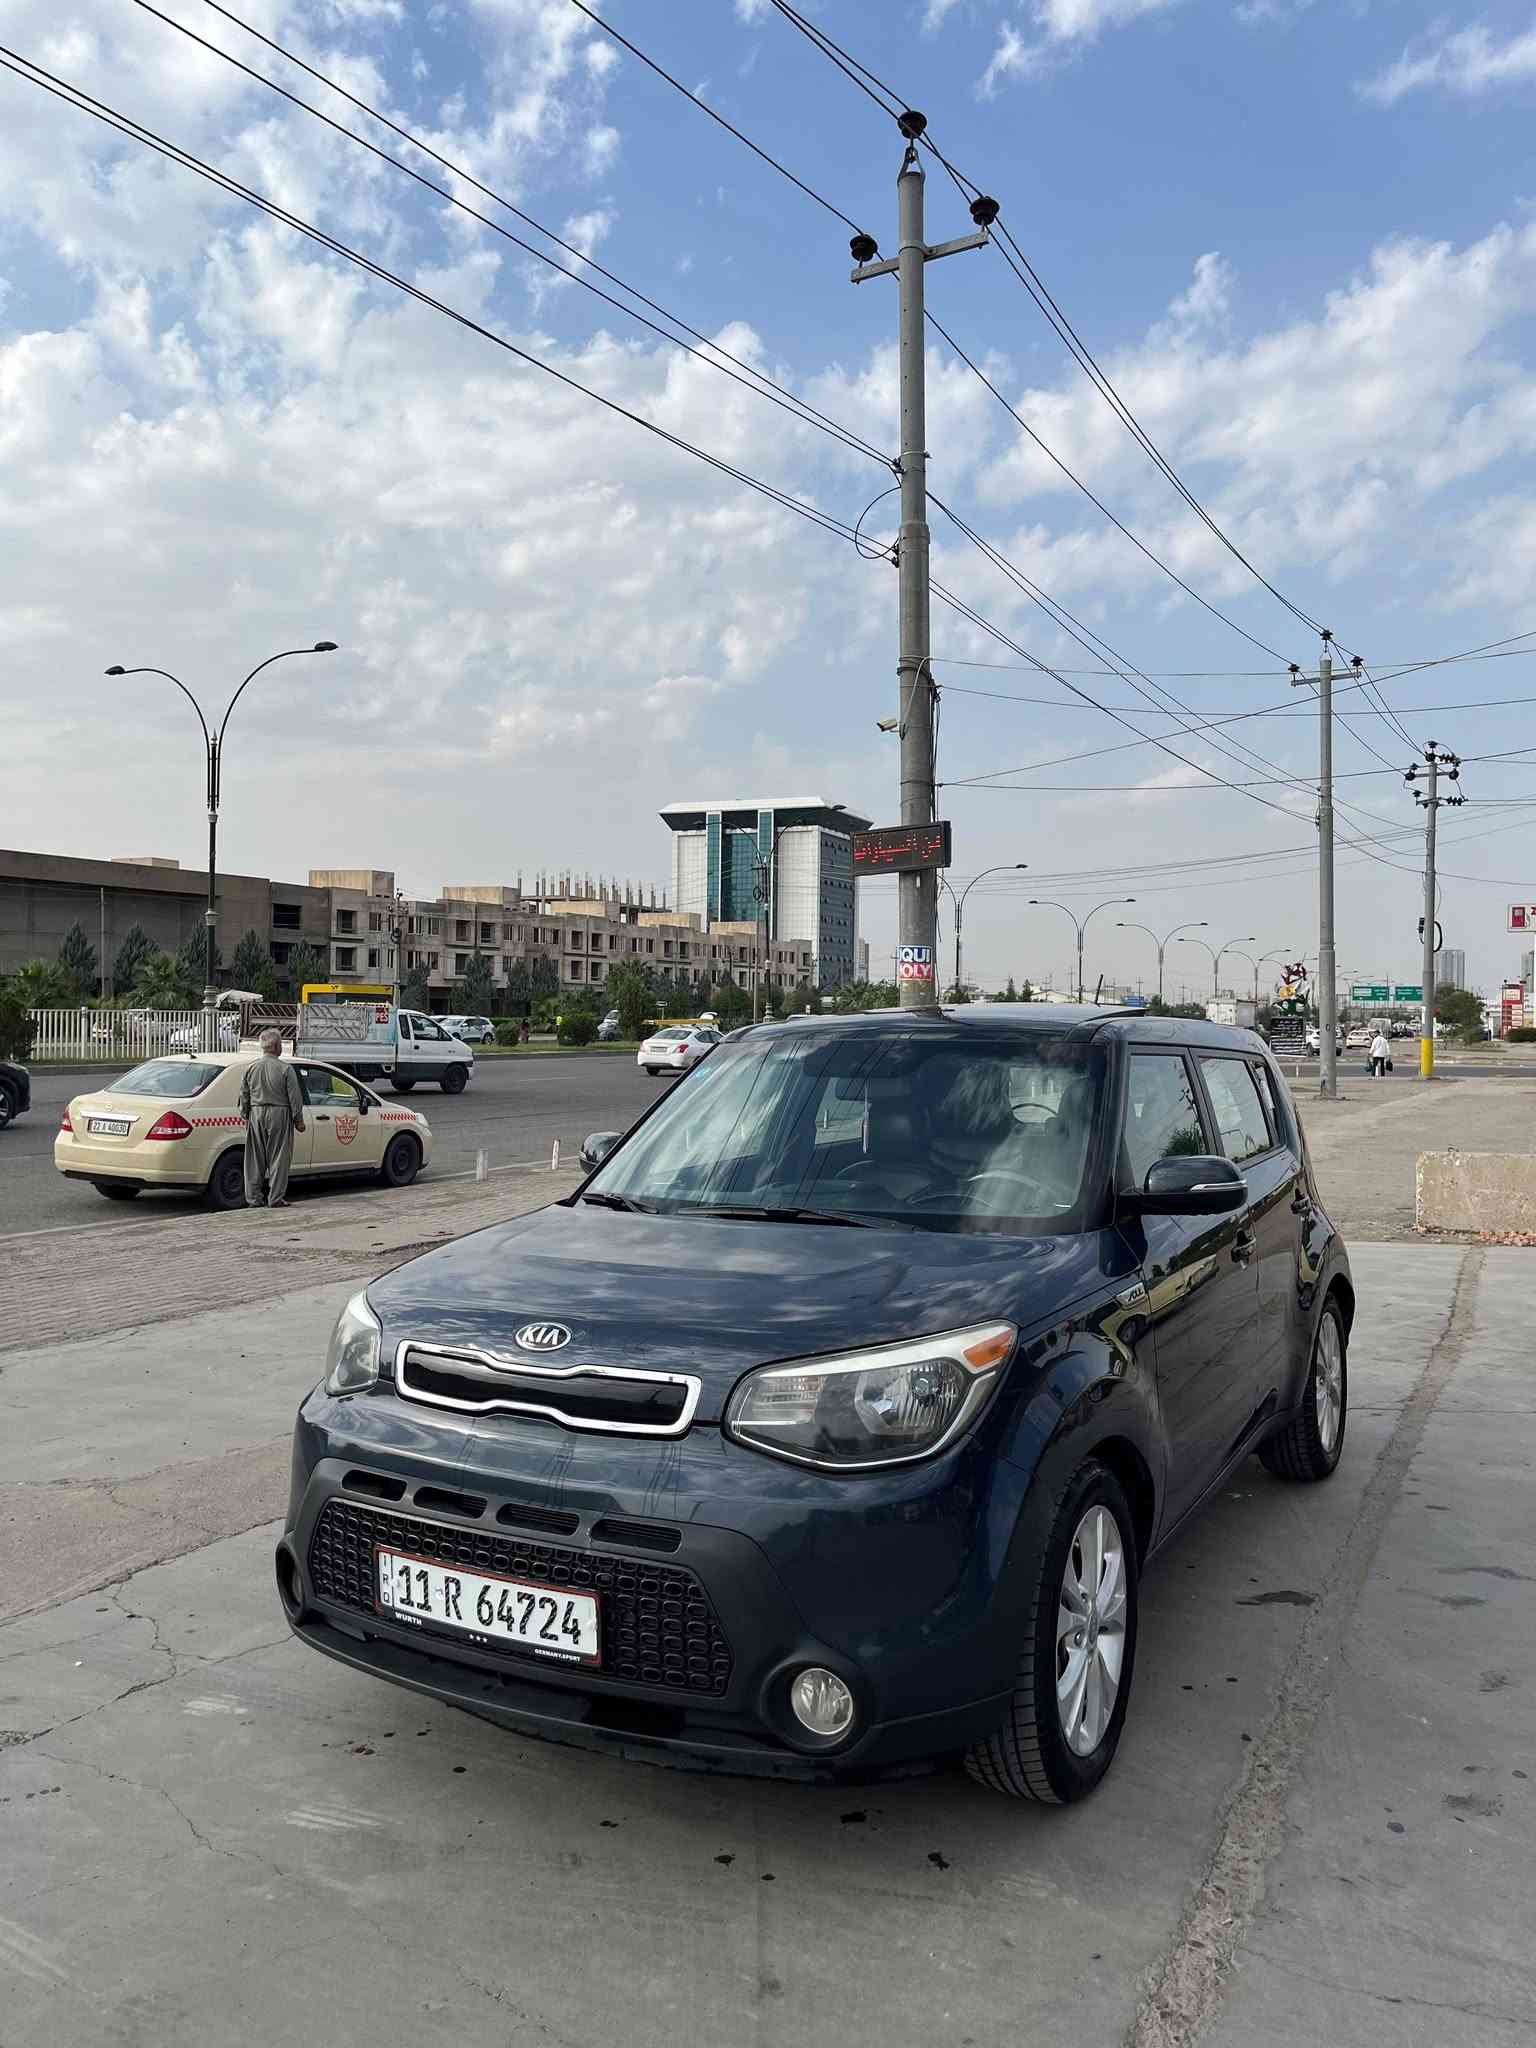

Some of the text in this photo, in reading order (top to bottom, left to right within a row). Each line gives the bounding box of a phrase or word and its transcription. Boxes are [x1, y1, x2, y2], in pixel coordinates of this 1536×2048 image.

[521, 1326, 560, 1346] KIA
[398, 1564, 582, 1645] 11 R 64724
